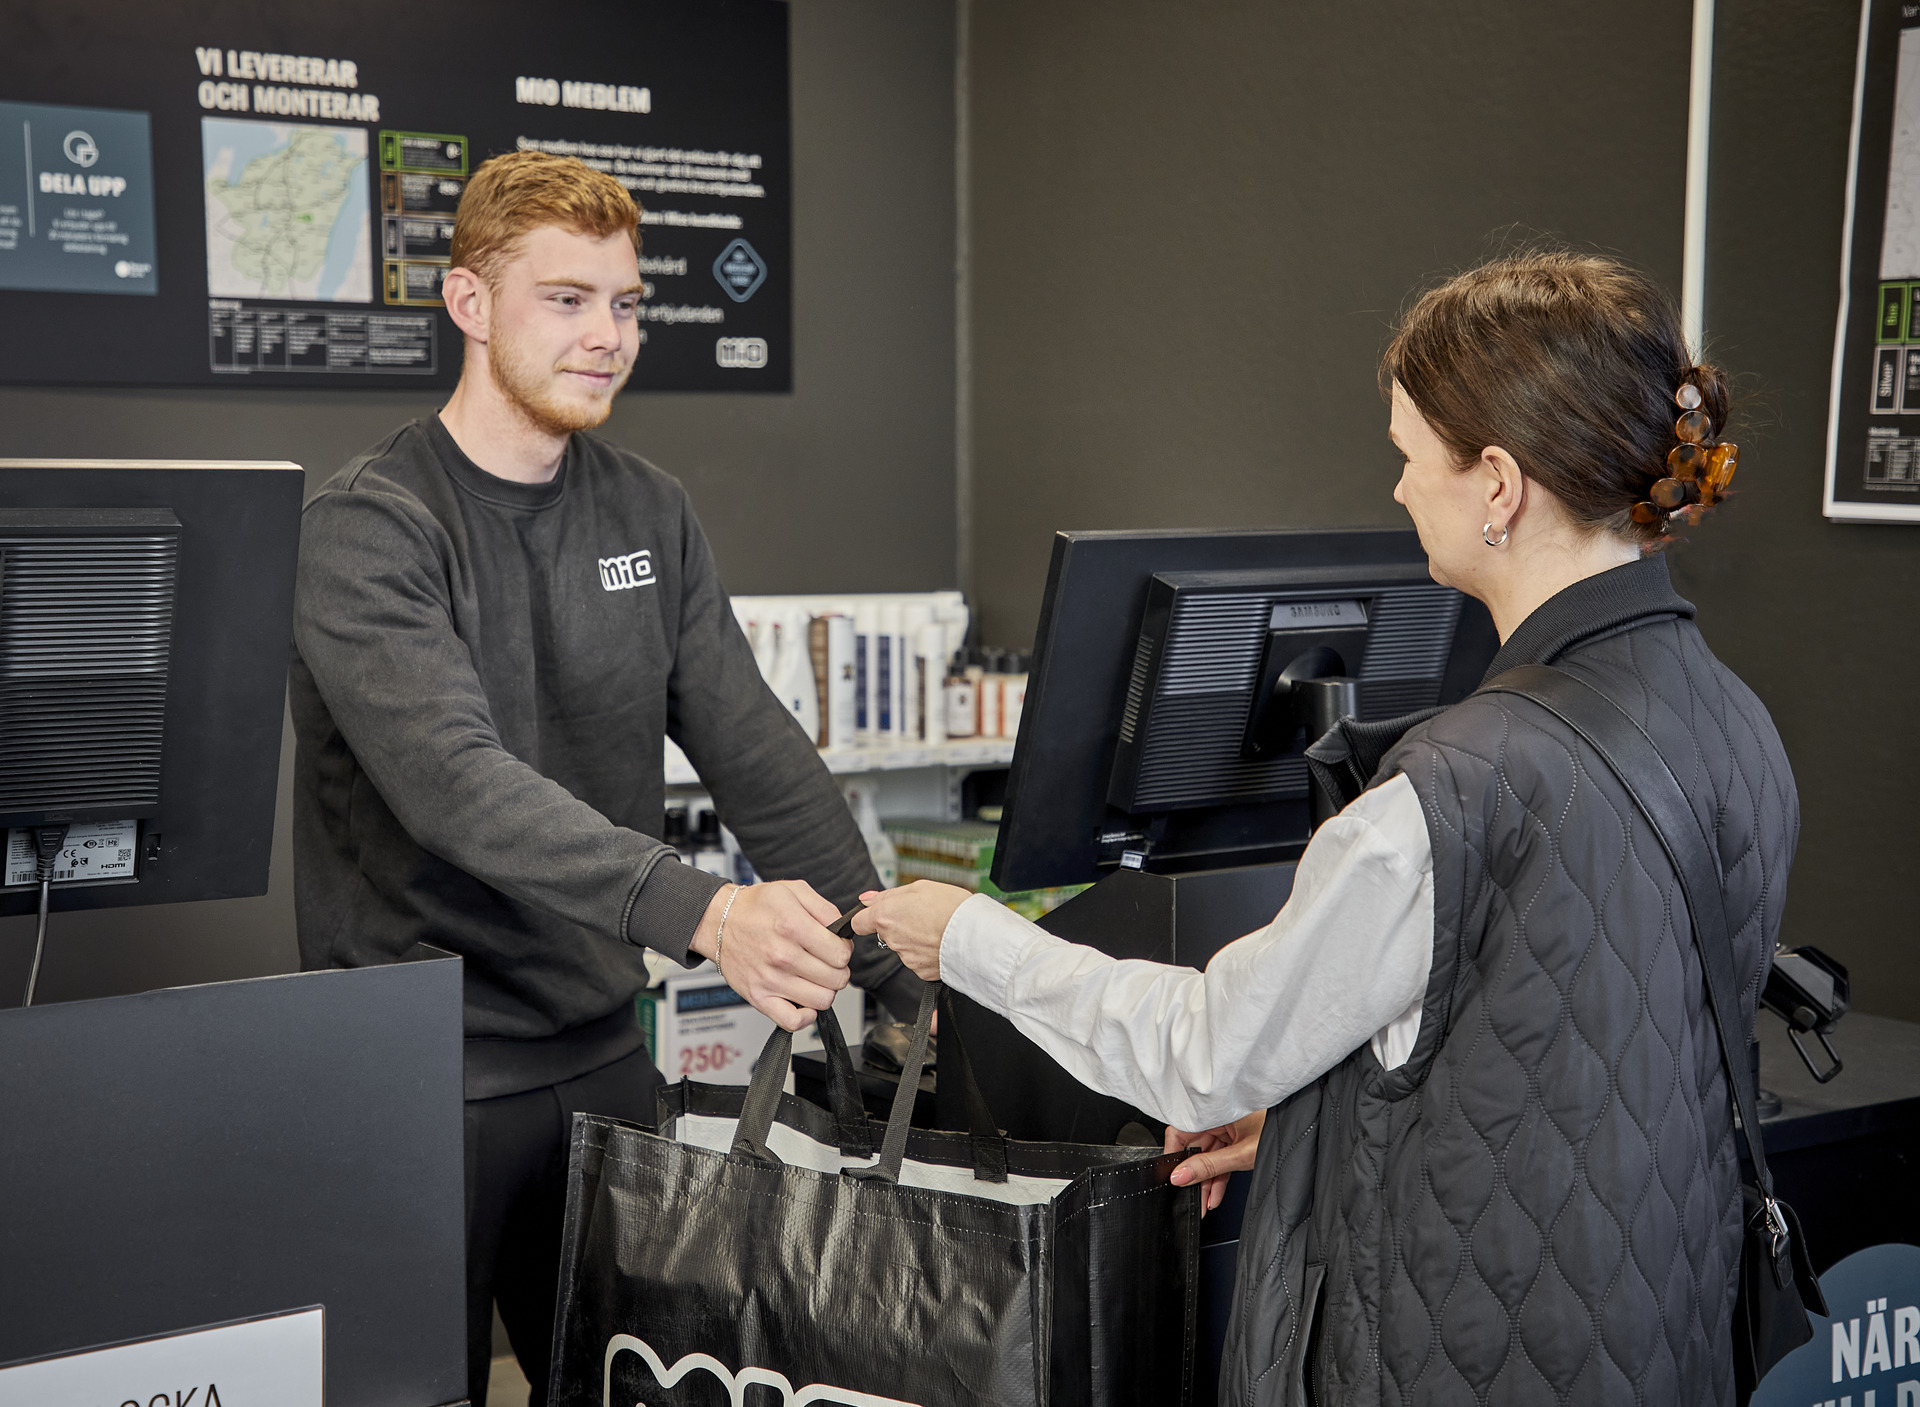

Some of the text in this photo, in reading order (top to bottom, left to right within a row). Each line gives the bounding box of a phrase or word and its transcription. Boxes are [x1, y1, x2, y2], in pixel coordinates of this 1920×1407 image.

[196, 47, 358, 88] VI LEVERERAR
[198, 80, 380, 122] OCH MONTERAR
[516, 76, 650, 114] MIO MEDLEM
[39, 172, 127, 197] DELA UPP
[1290, 604, 1341, 618] SAMSUNG
[1831, 1297, 1920, 1384] NÄR
